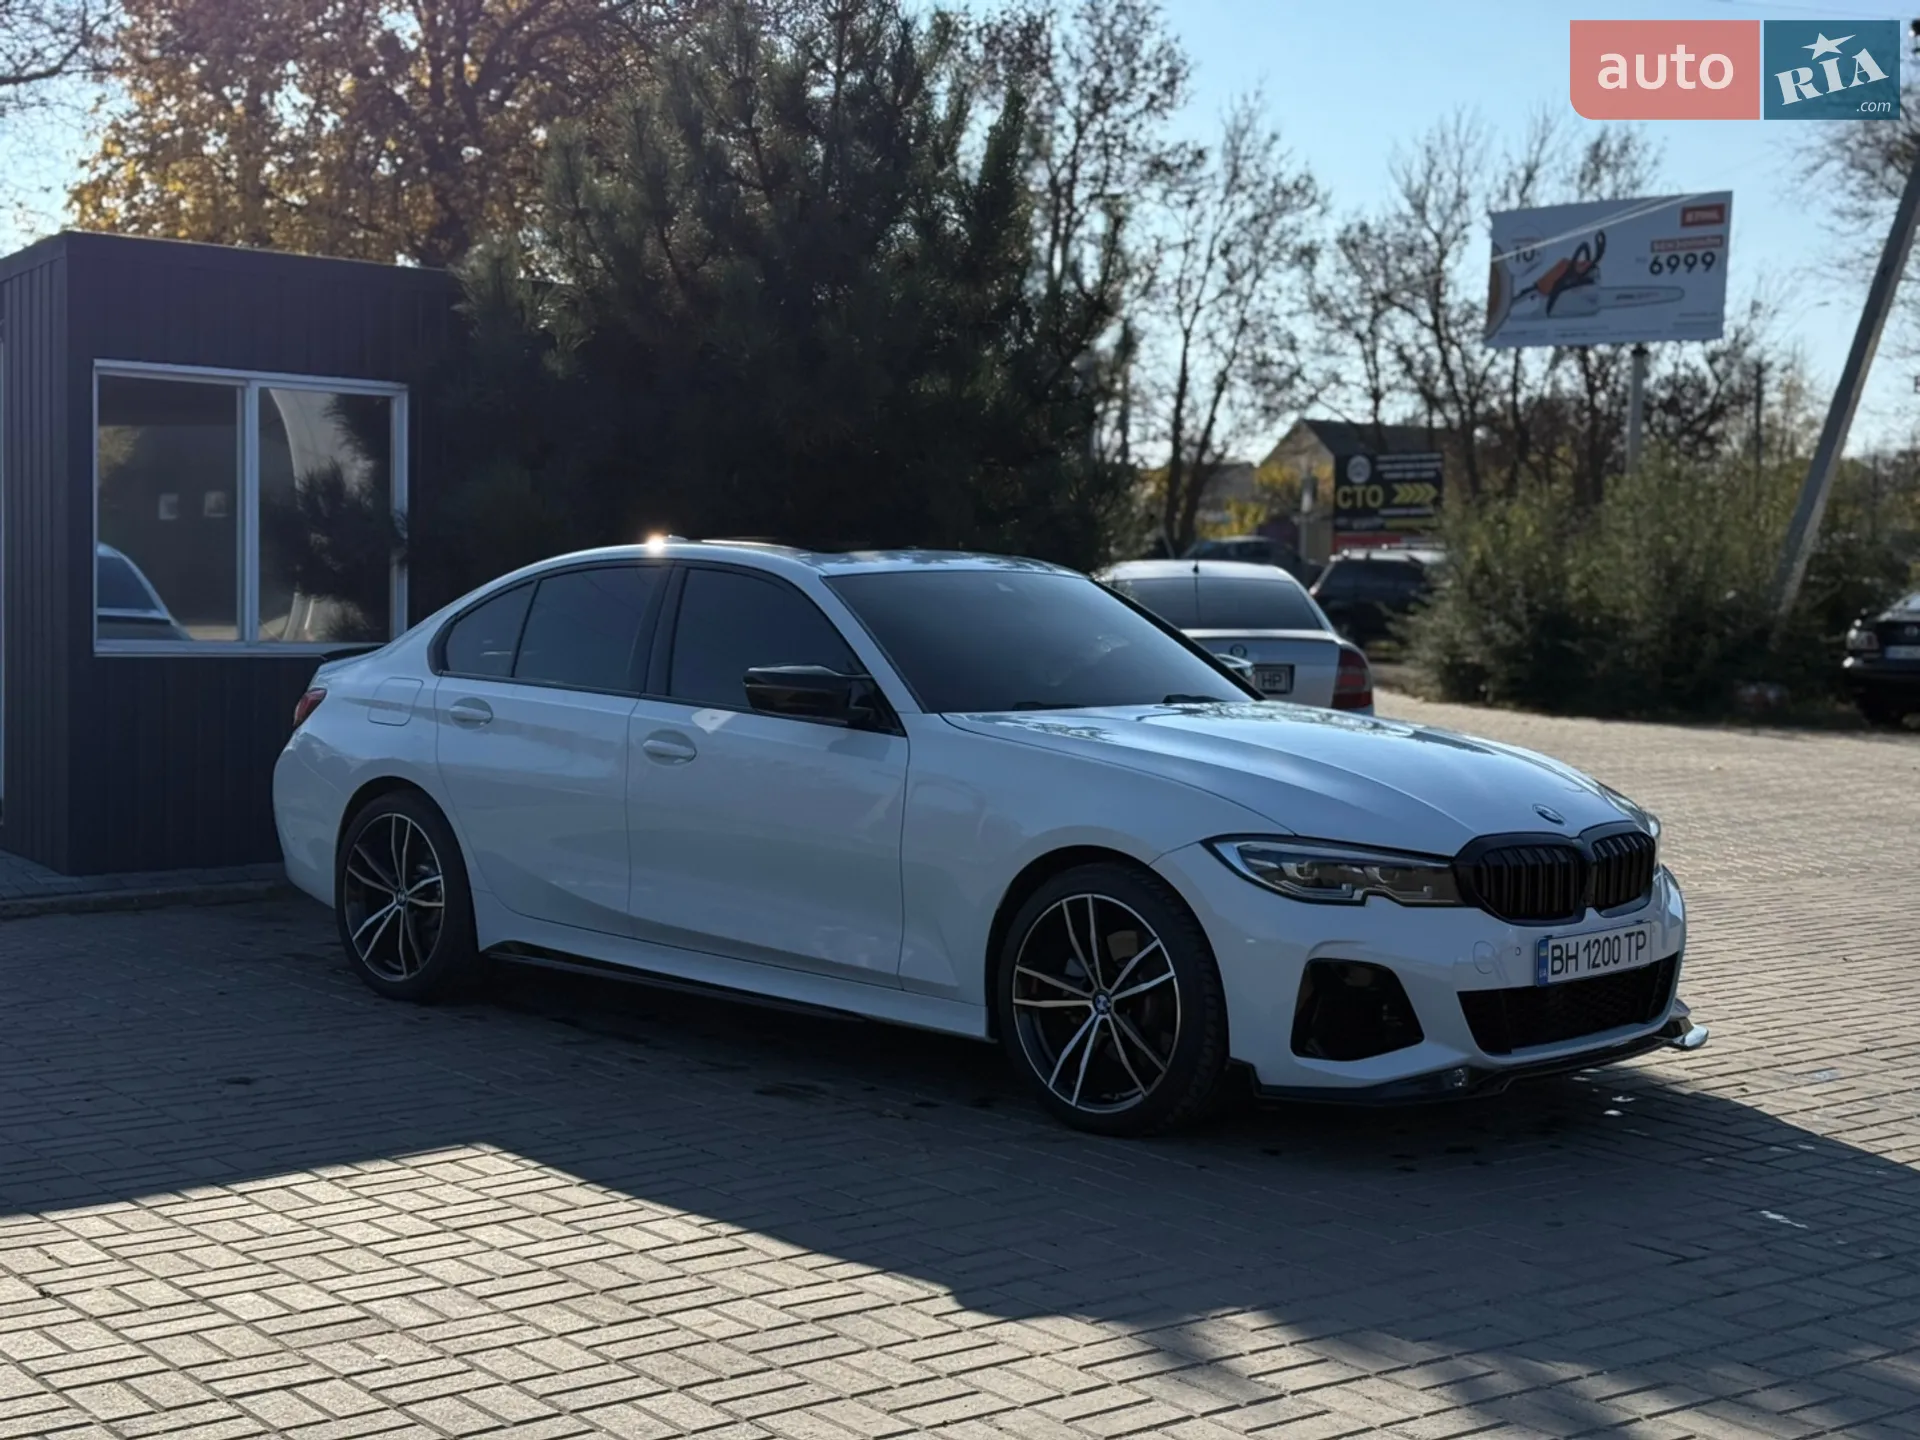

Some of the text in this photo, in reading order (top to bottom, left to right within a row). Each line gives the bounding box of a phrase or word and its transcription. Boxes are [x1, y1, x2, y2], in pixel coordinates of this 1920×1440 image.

[1649, 250, 1716, 276] 6999
[1551, 930, 1647, 976] BH 1200 TP
